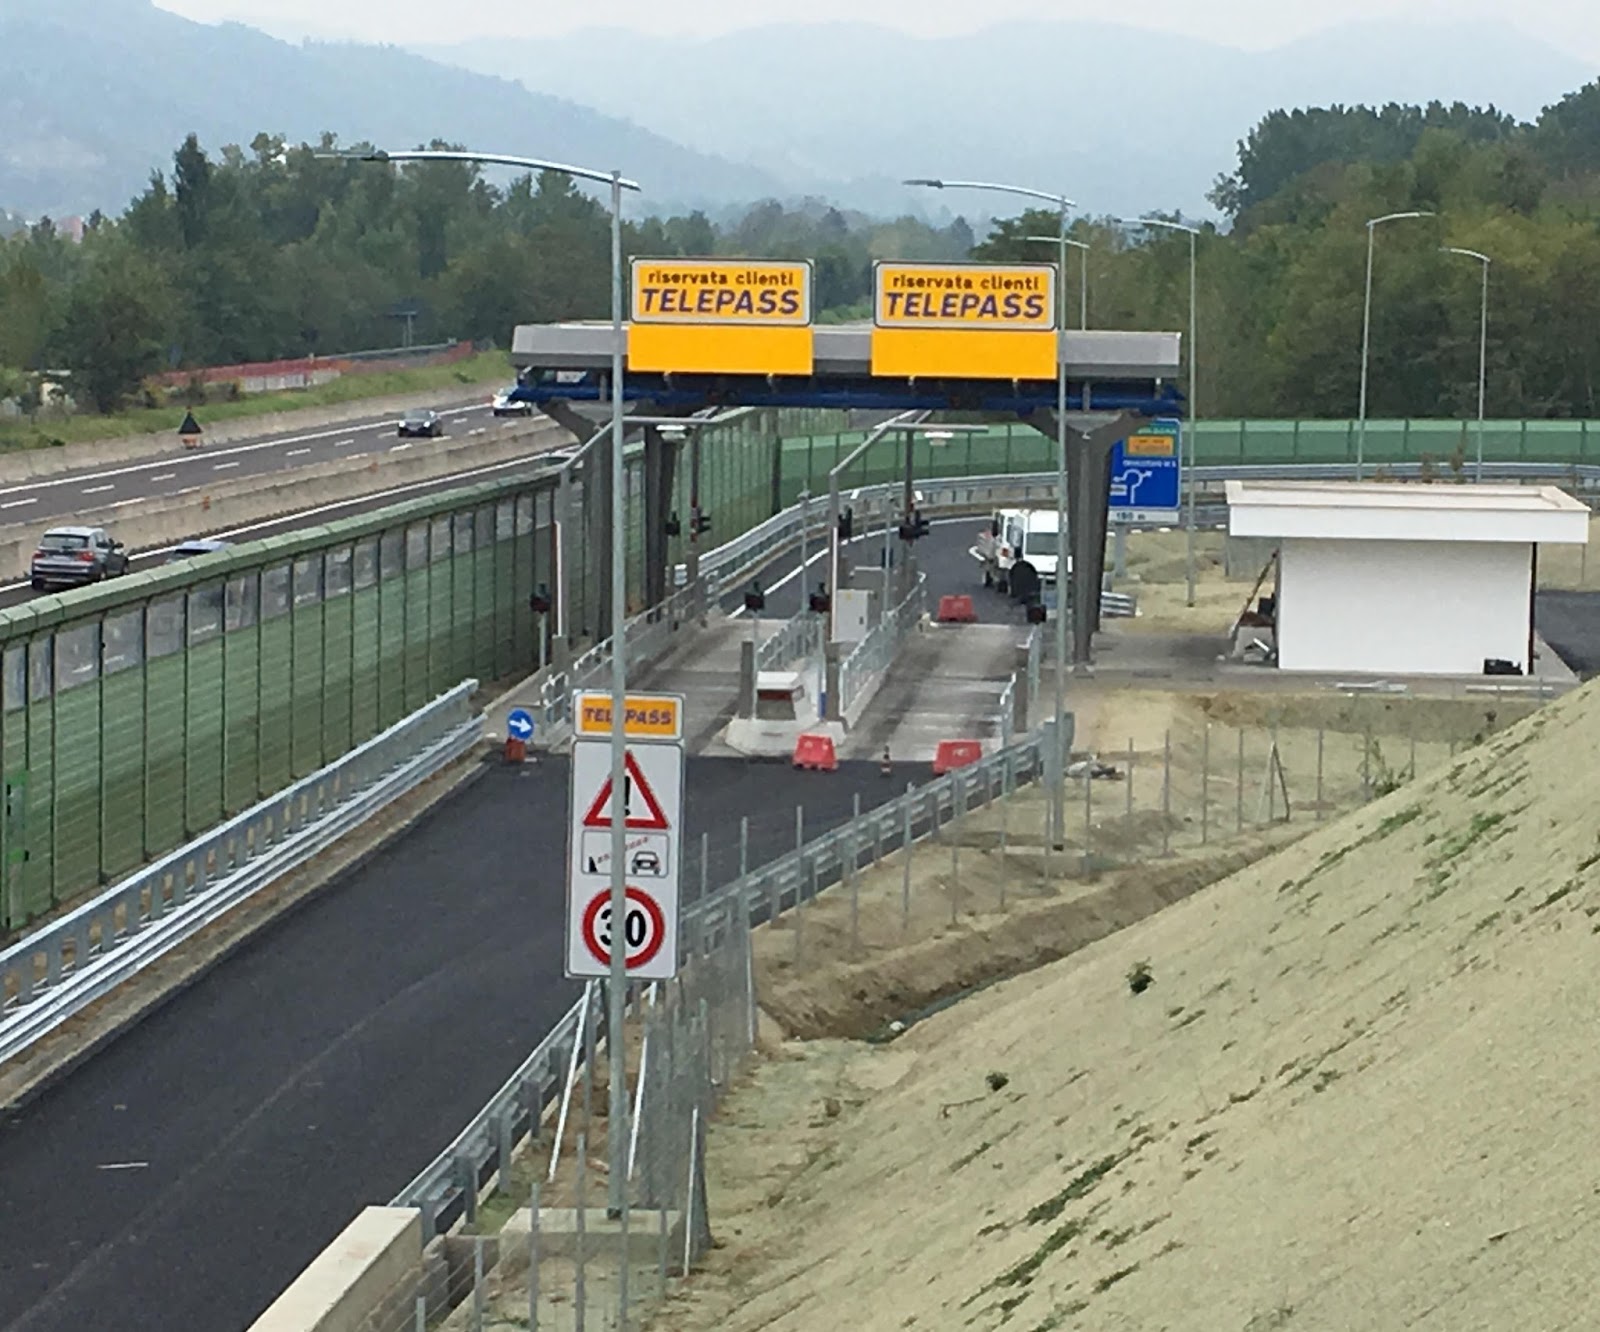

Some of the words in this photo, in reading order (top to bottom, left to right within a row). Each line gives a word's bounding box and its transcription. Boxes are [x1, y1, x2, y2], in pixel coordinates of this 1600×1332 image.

[648, 271, 729, 286] riservata
[735, 271, 794, 286] clienti
[892, 274, 974, 290] riservata
[980, 275, 1039, 291] clienti
[641, 288, 800, 315] TELEPASS
[885, 292, 1045, 319] TELEPASS
[584, 707, 672, 726] TELPASS
[599, 908, 647, 948] 30
